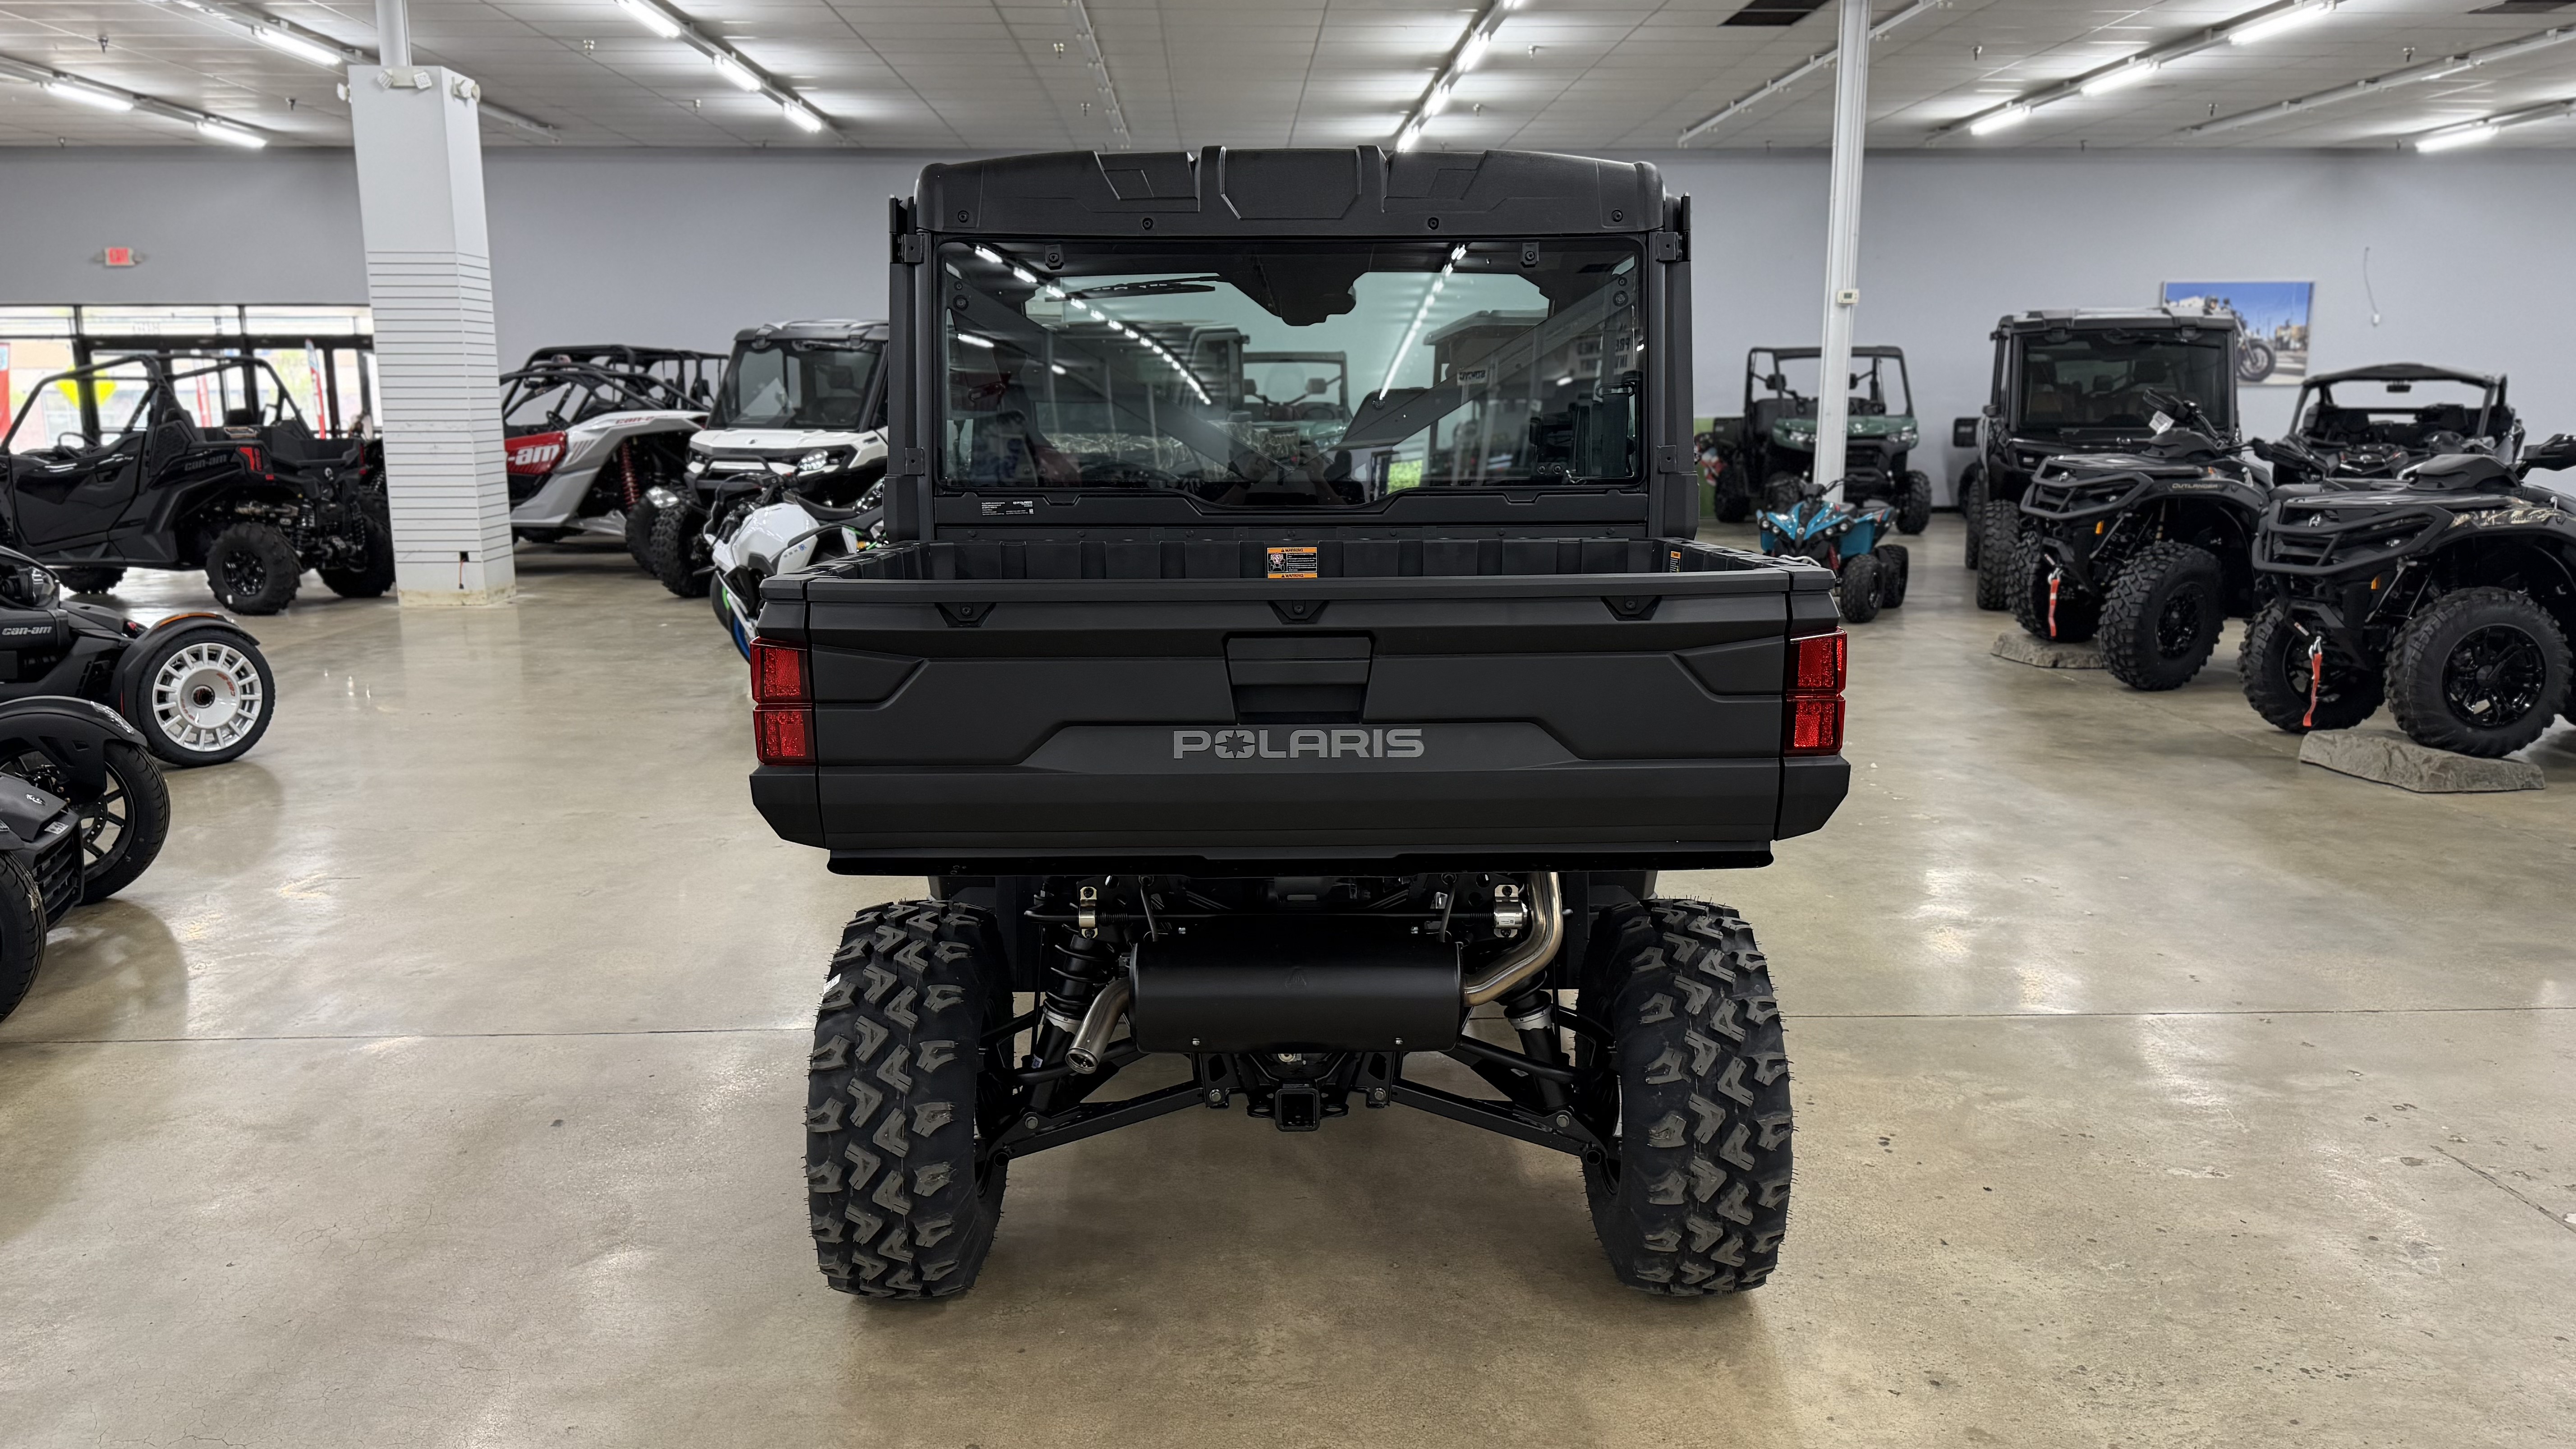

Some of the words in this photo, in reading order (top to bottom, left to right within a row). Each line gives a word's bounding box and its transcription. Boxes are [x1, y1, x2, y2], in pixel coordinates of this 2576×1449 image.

[184, 454, 227, 471] can-am
[2, 626, 52, 636] can-am
[1173, 729, 1425, 759] POLARIS
